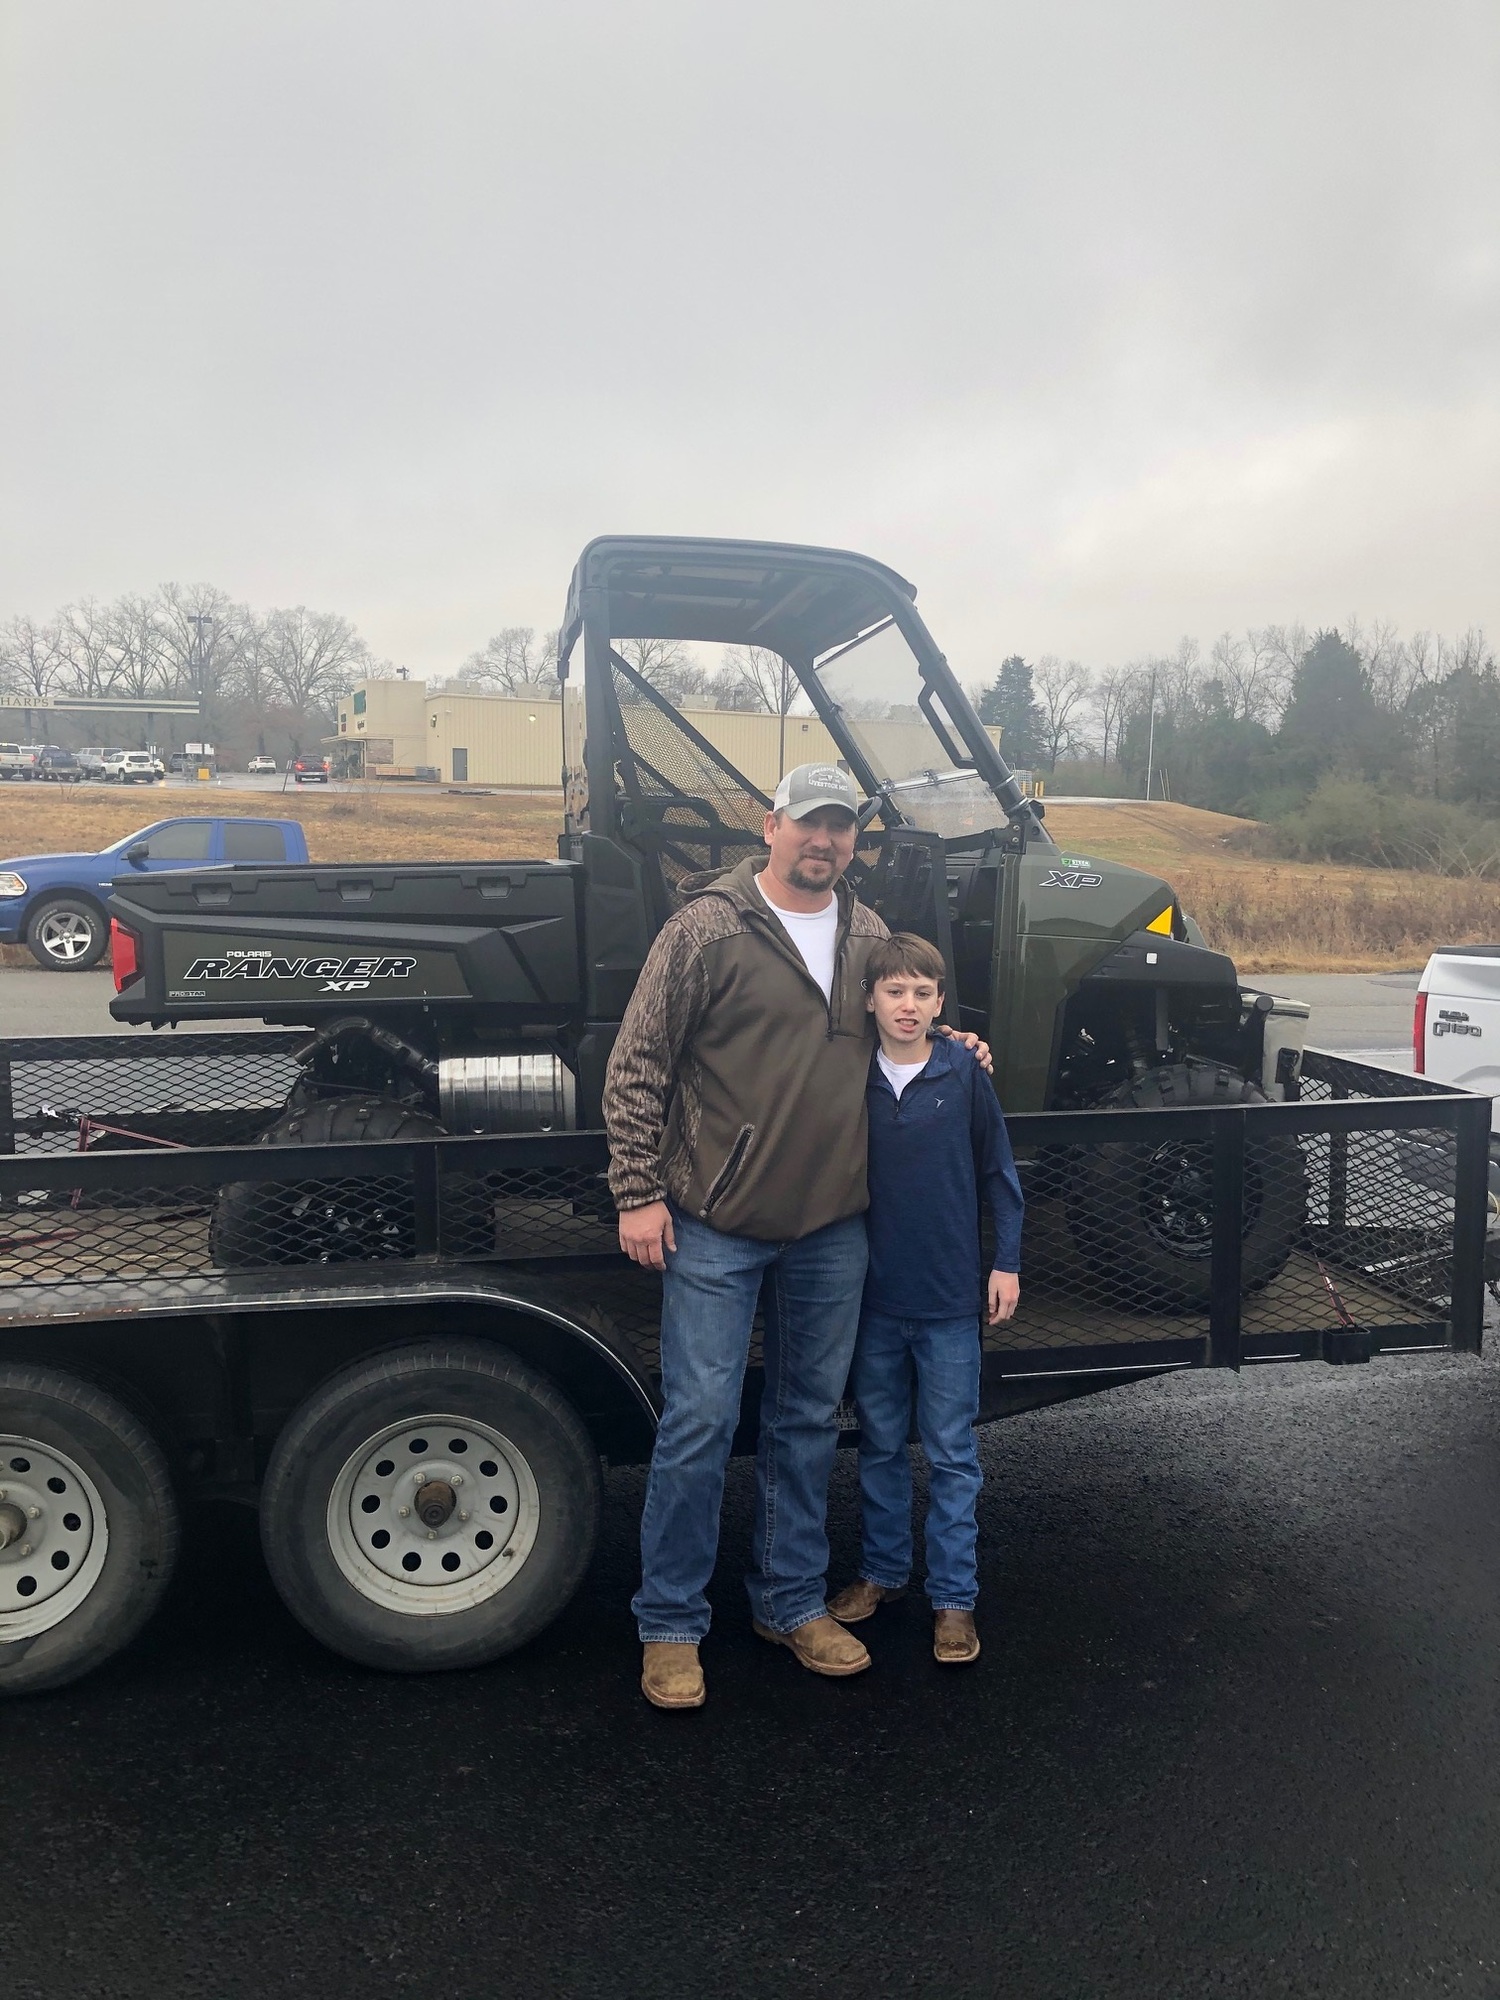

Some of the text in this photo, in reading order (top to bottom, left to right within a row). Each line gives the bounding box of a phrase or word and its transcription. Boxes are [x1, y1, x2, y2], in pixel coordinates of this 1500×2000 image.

[1, 697, 49, 707] HARPS
[1039, 870, 1103, 889] XP
[226, 950, 272, 958] POLARIS
[183, 957, 417, 980] RANGER
[316, 980, 371, 992] XP
